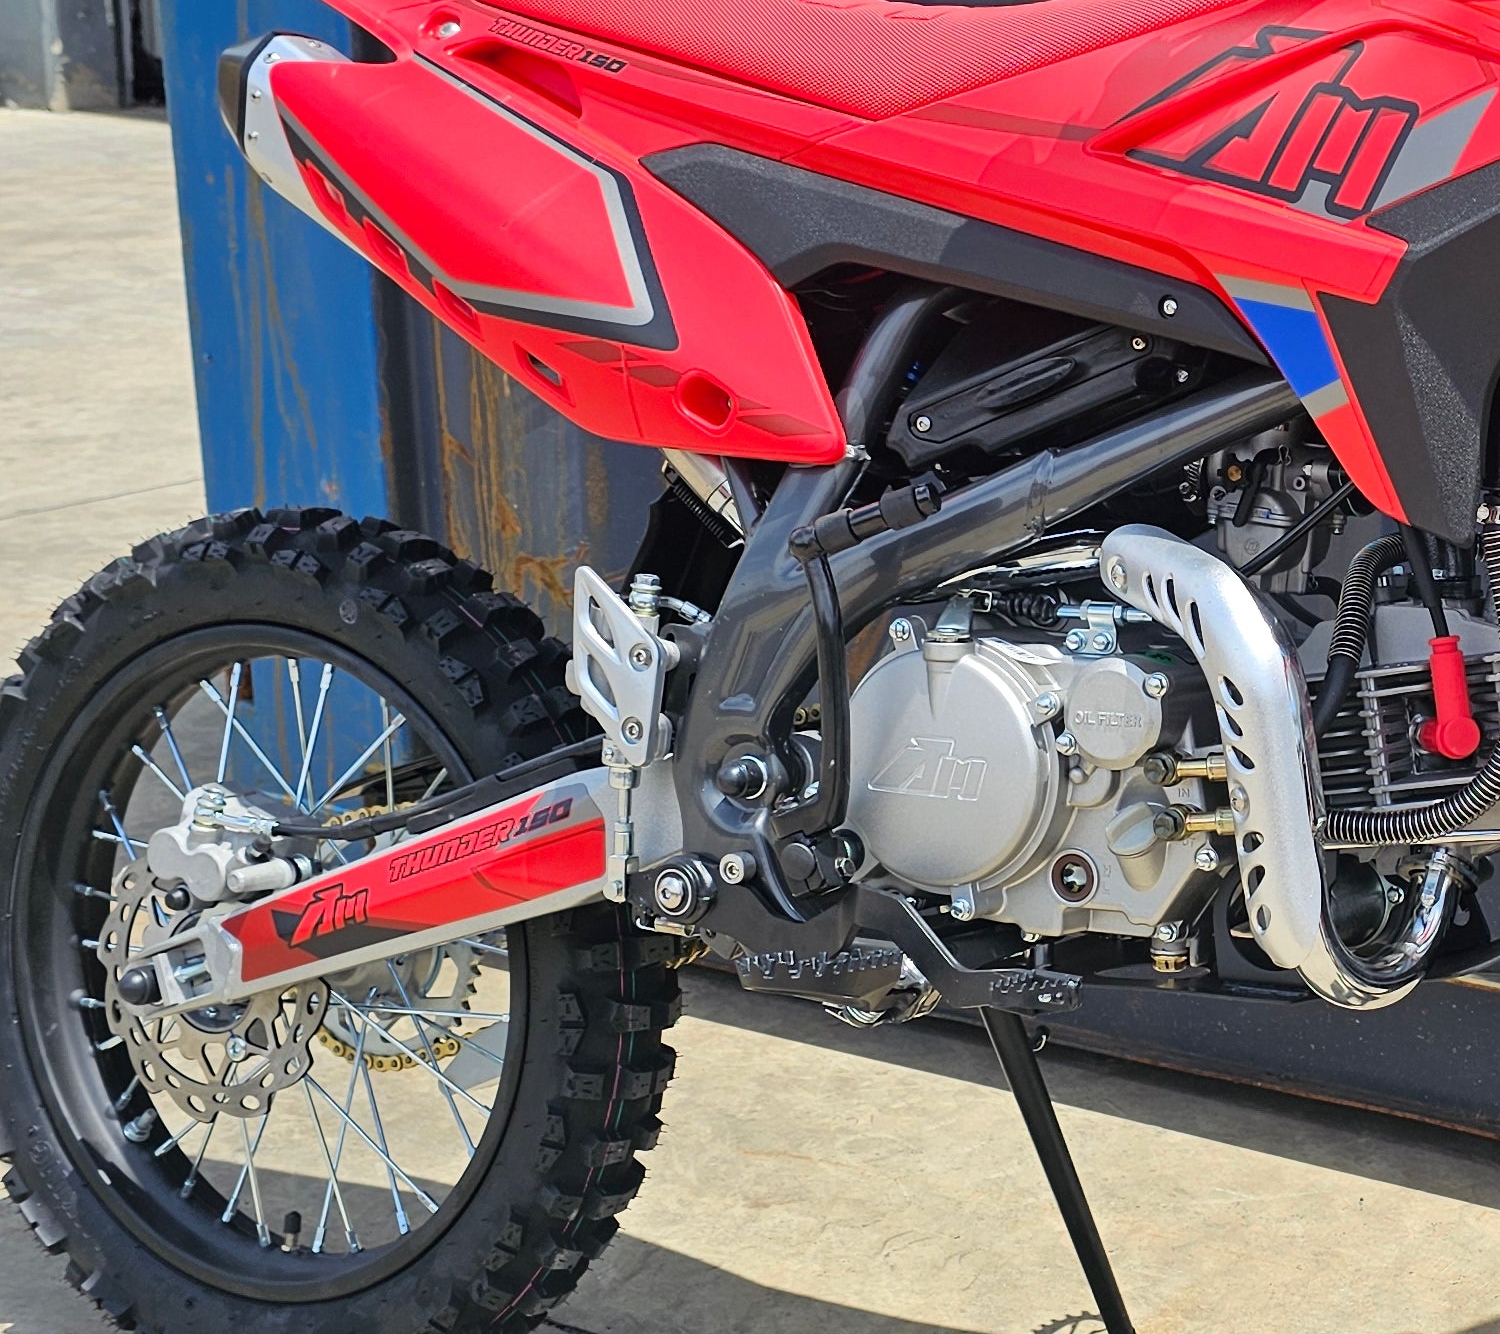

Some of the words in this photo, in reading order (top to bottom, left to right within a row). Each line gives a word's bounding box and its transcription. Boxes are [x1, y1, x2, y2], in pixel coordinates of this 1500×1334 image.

[488, 17, 584, 60] THUNDER
[576, 50, 628, 73] 150
[1074, 710, 1096, 725] OIL
[1098, 711, 1143, 728] FILTER
[1178, 788, 1190, 798] IN
[388, 818, 516, 883] THUNDER
[513, 797, 573, 837] 150
